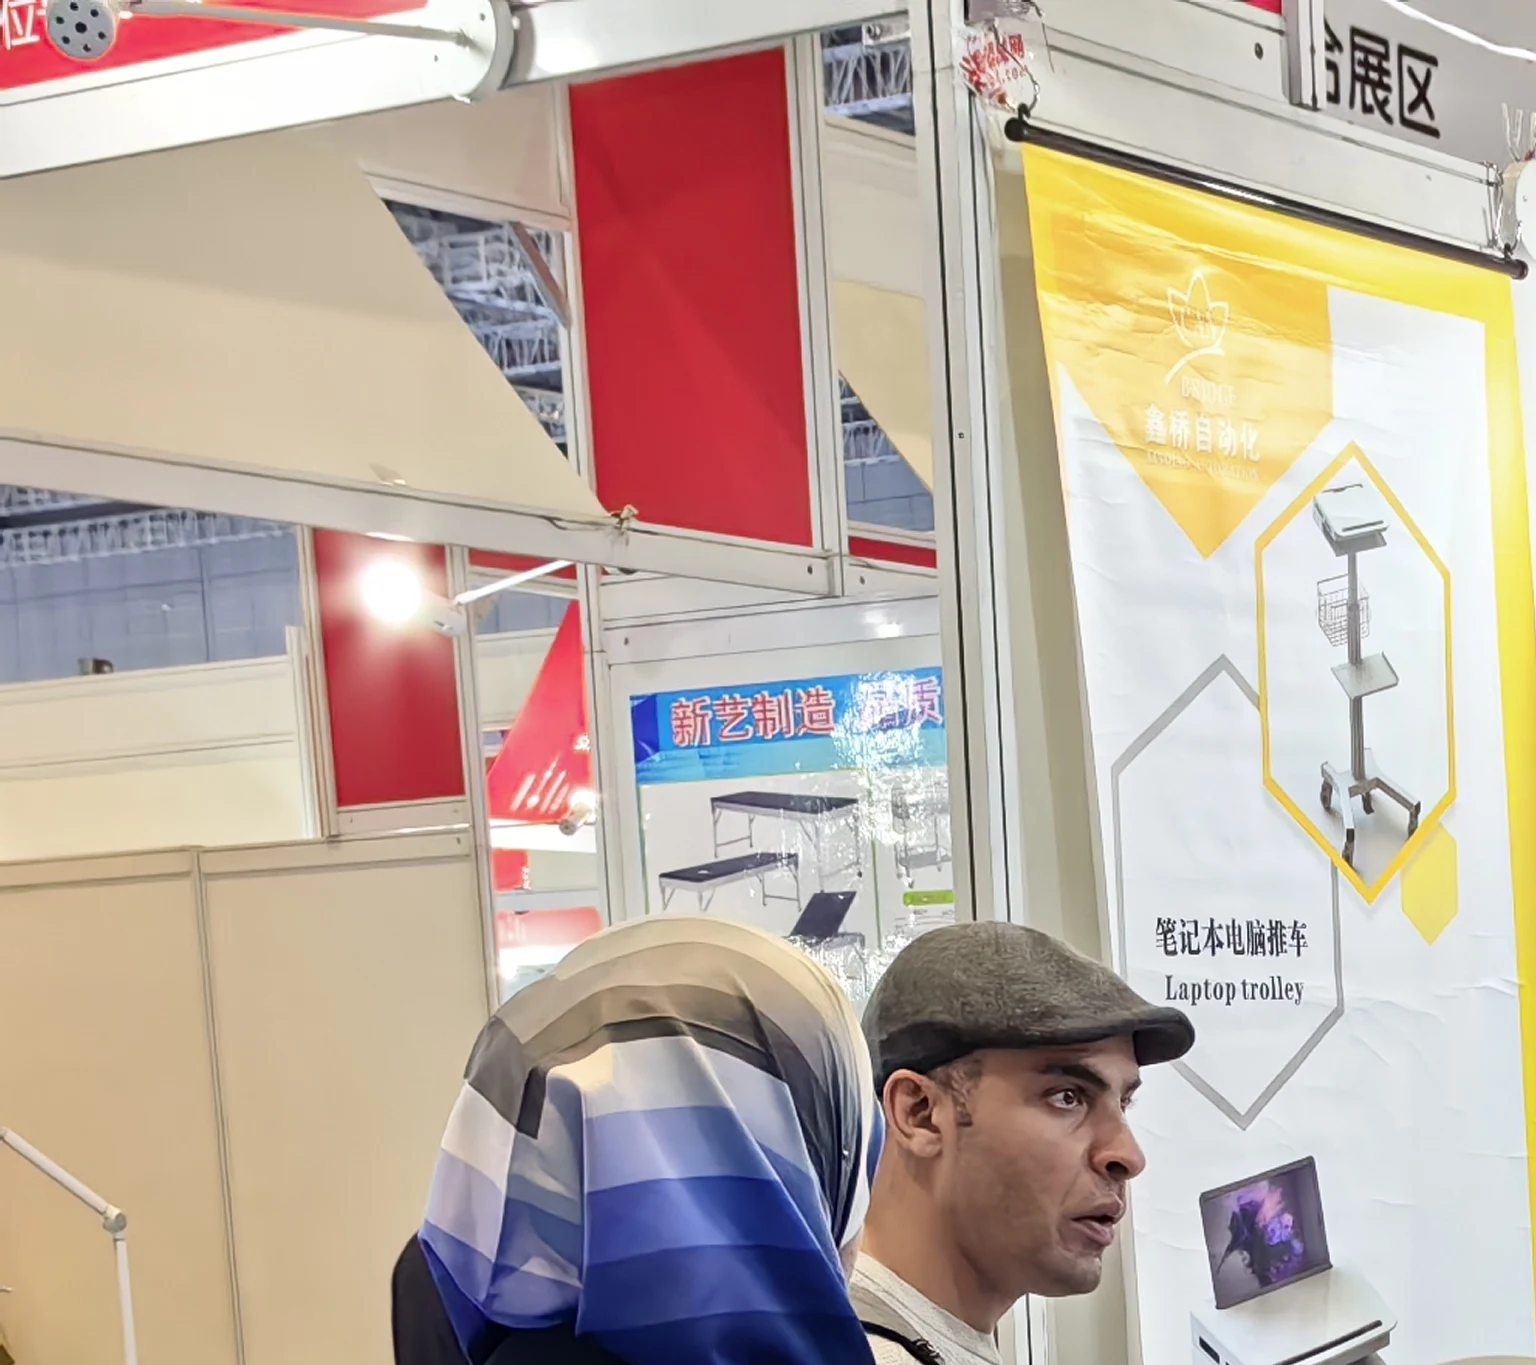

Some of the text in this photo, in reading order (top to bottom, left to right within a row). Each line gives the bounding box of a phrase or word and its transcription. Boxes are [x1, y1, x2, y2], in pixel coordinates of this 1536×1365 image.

[0, 0, 46, 50] 位
[1145, 403, 1260, 462] 鑫桥自动化
[671, 684, 836, 749] 新艺制造
[1155, 917, 1309, 957] 笔记本电脑推车
[1165, 974, 1304, 1006] Laptop trolley
